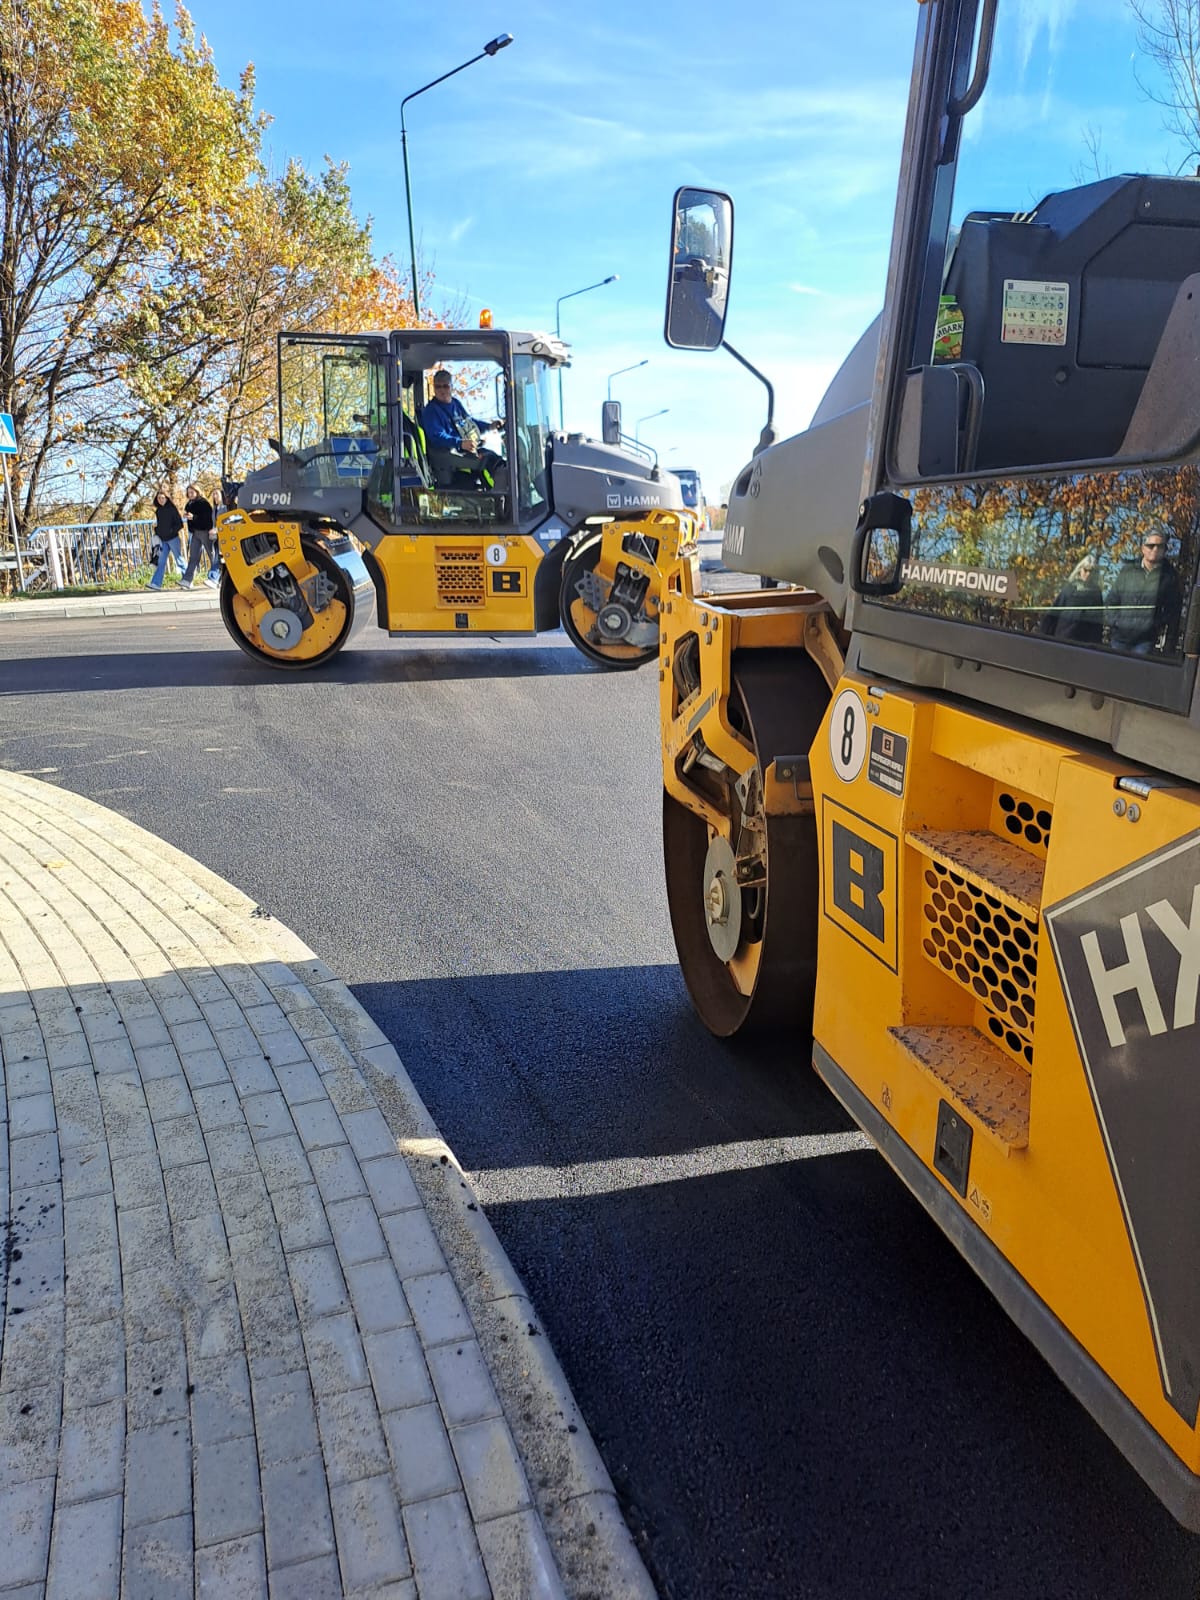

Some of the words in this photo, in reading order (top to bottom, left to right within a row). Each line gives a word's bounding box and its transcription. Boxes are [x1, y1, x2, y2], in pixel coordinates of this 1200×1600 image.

[623, 495, 660, 506] HAMM
[493, 547, 500, 562] 8
[492, 571, 521, 593] B
[901, 563, 1008, 594] HAMMTRONIC
[842, 706, 855, 765] 8
[833, 819, 885, 944] B
[1079, 883, 1200, 1048] HY
